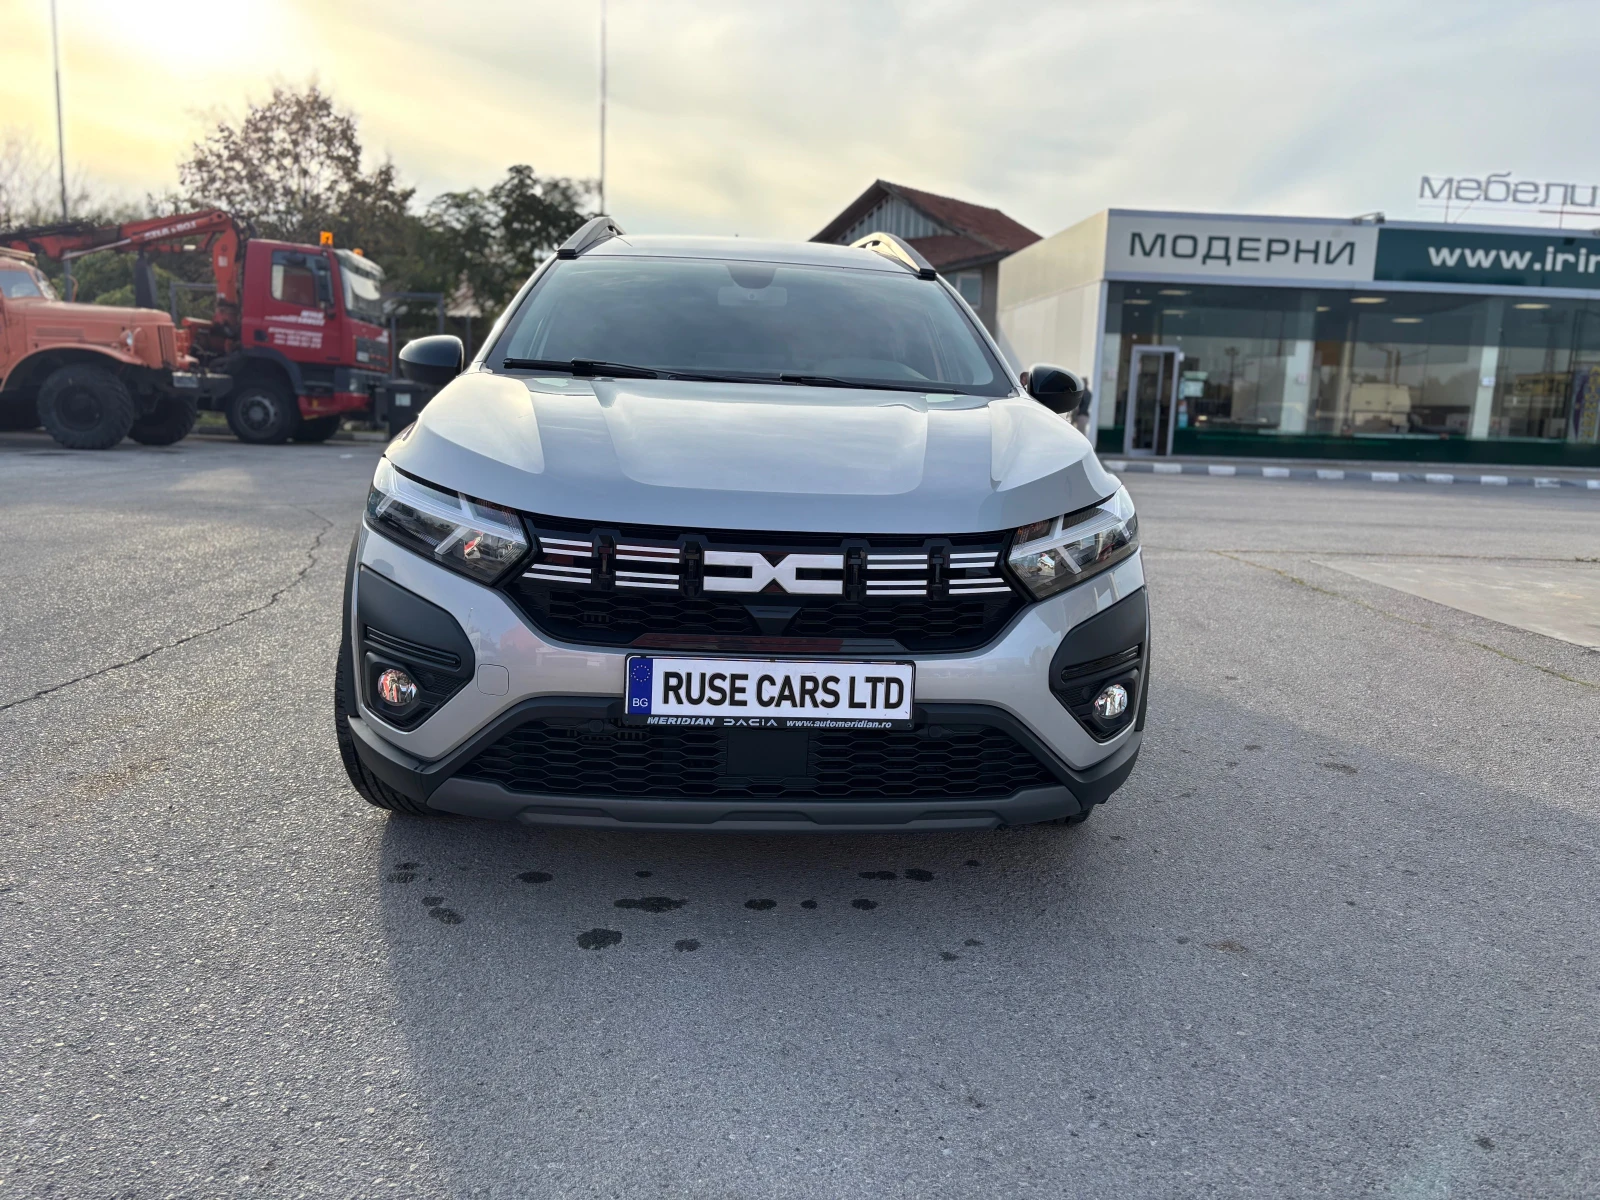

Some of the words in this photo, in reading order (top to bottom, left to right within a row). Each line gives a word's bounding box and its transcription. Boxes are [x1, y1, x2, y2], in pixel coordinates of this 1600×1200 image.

[1419, 171, 1598, 207] мебели
[1129, 232, 1356, 266] МОДЕРНИ
[632, 697, 648, 708] BG
[663, 671, 748, 707] RUSE
[756, 674, 841, 709] CARS
[848, 676, 905, 709] LTD
[647, 716, 715, 726] MERIDIAN
[723, 718, 778, 727] DACIA
[786, 720, 892, 729] www.automeridian.ro
